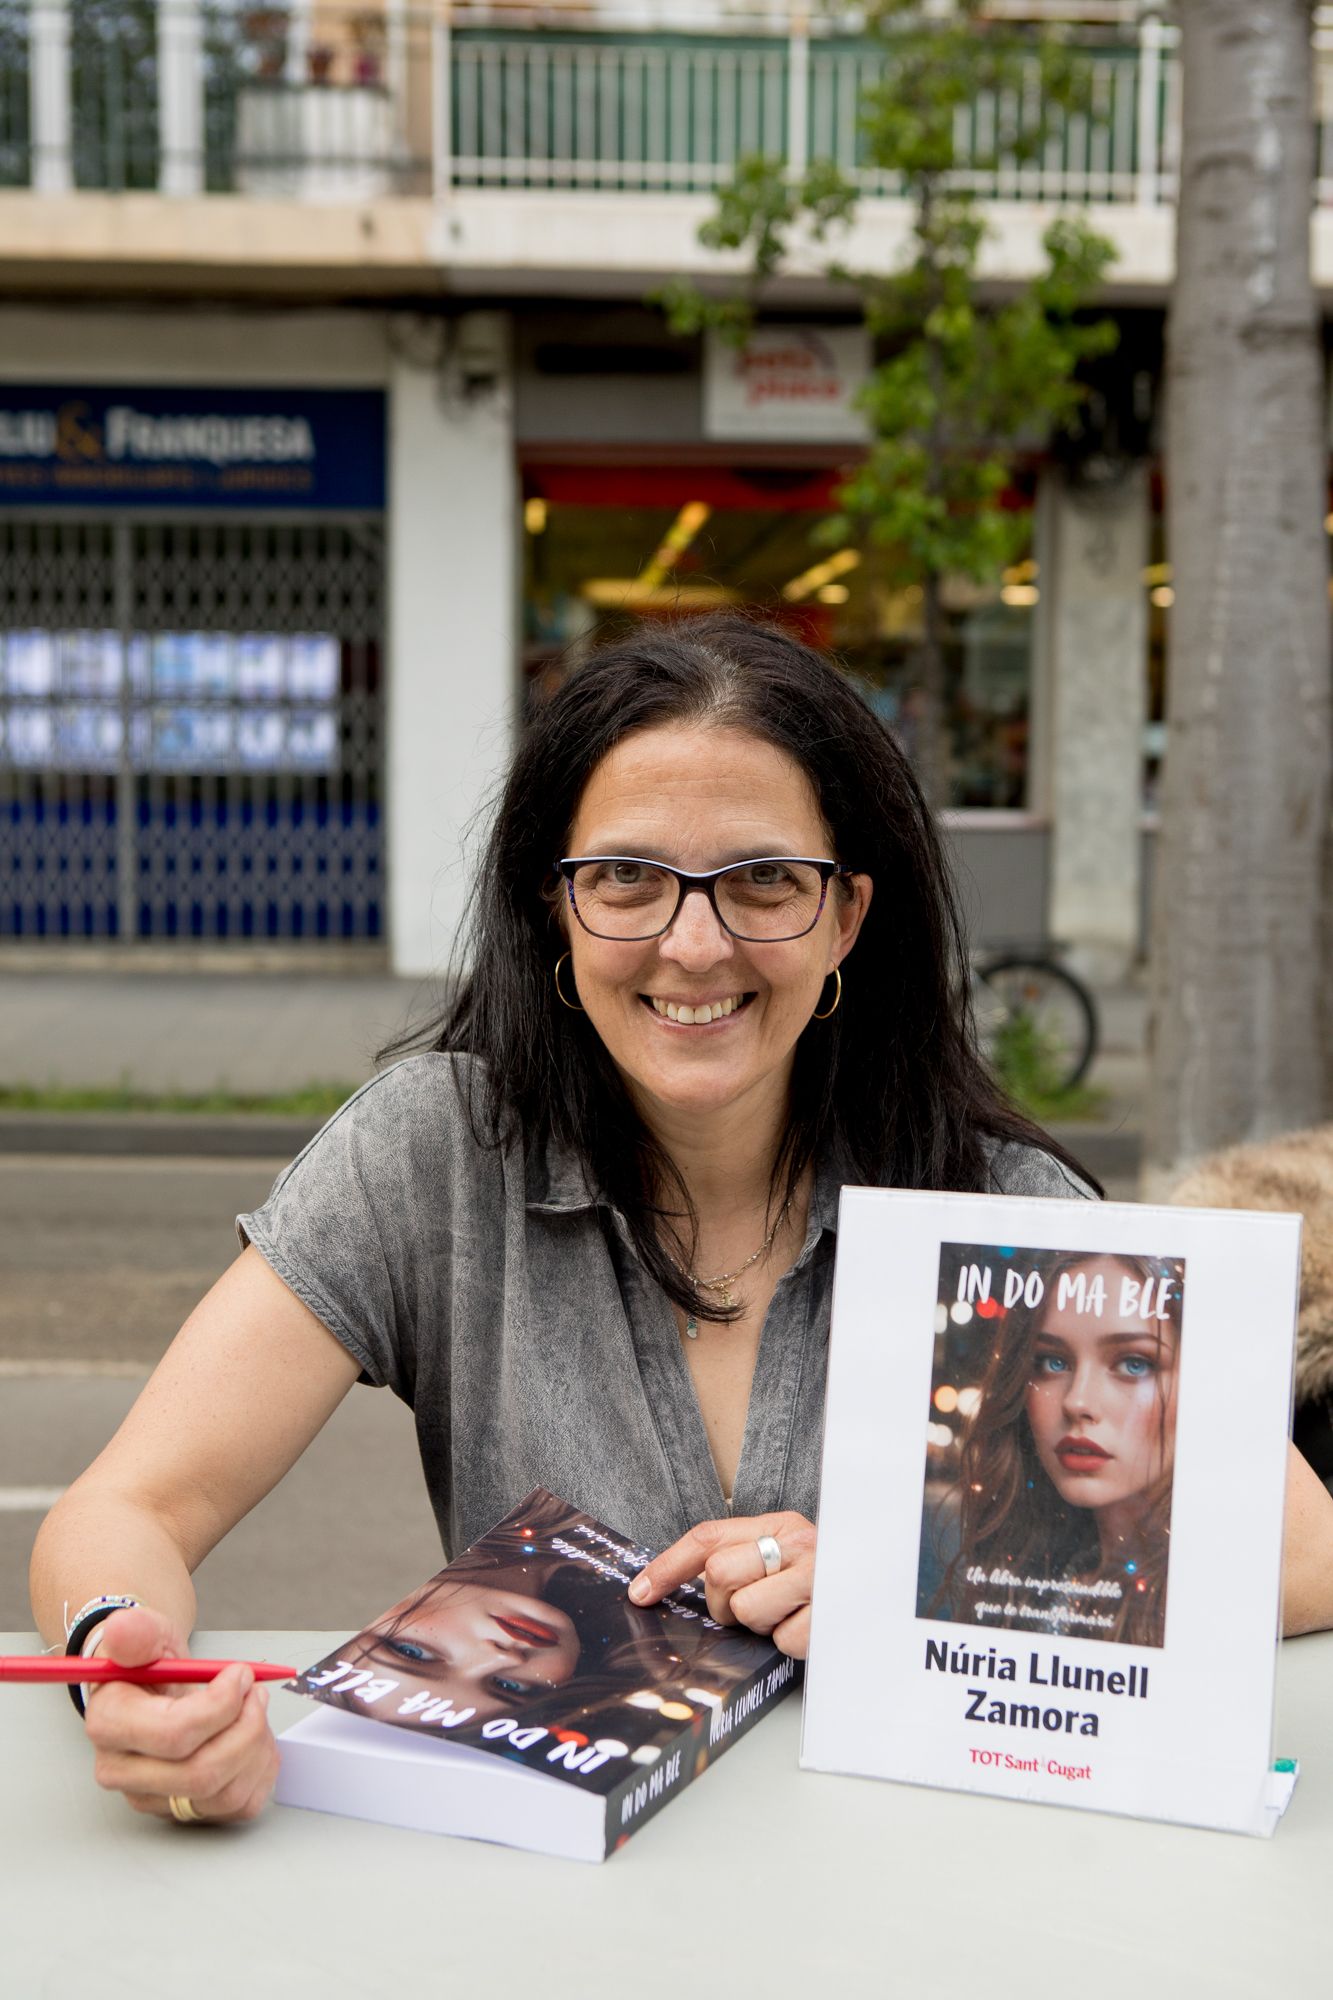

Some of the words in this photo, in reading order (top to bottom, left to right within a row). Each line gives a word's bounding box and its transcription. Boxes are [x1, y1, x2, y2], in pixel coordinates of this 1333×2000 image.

[957, 1263, 992, 1304] IN
[1003, 1268, 1045, 1309] DO
[1057, 1272, 1108, 1318] MA
[1118, 1276, 1176, 1320] BLE
[989, 1567, 1023, 1587] libro
[974, 1600, 1002, 1620] que
[1003, 1601, 1018, 1617] te
[307, 1660, 400, 1703] BLE
[925, 1638, 1017, 1682] Núria
[1029, 1652, 1149, 1699] Llunell
[398, 1690, 476, 1728] MA
[964, 1688, 1100, 1737] Zamora
[481, 1718, 549, 1750] DO
[546, 1740, 610, 1774] IN
[969, 1749, 1003, 1767] TOT
[1005, 1754, 1039, 1773] Sant
[1047, 1760, 1092, 1781] Cugat
[621, 1794, 633, 1825] IN
[634, 1781, 648, 1814] DO
[665, 1750, 682, 1787] BLE
